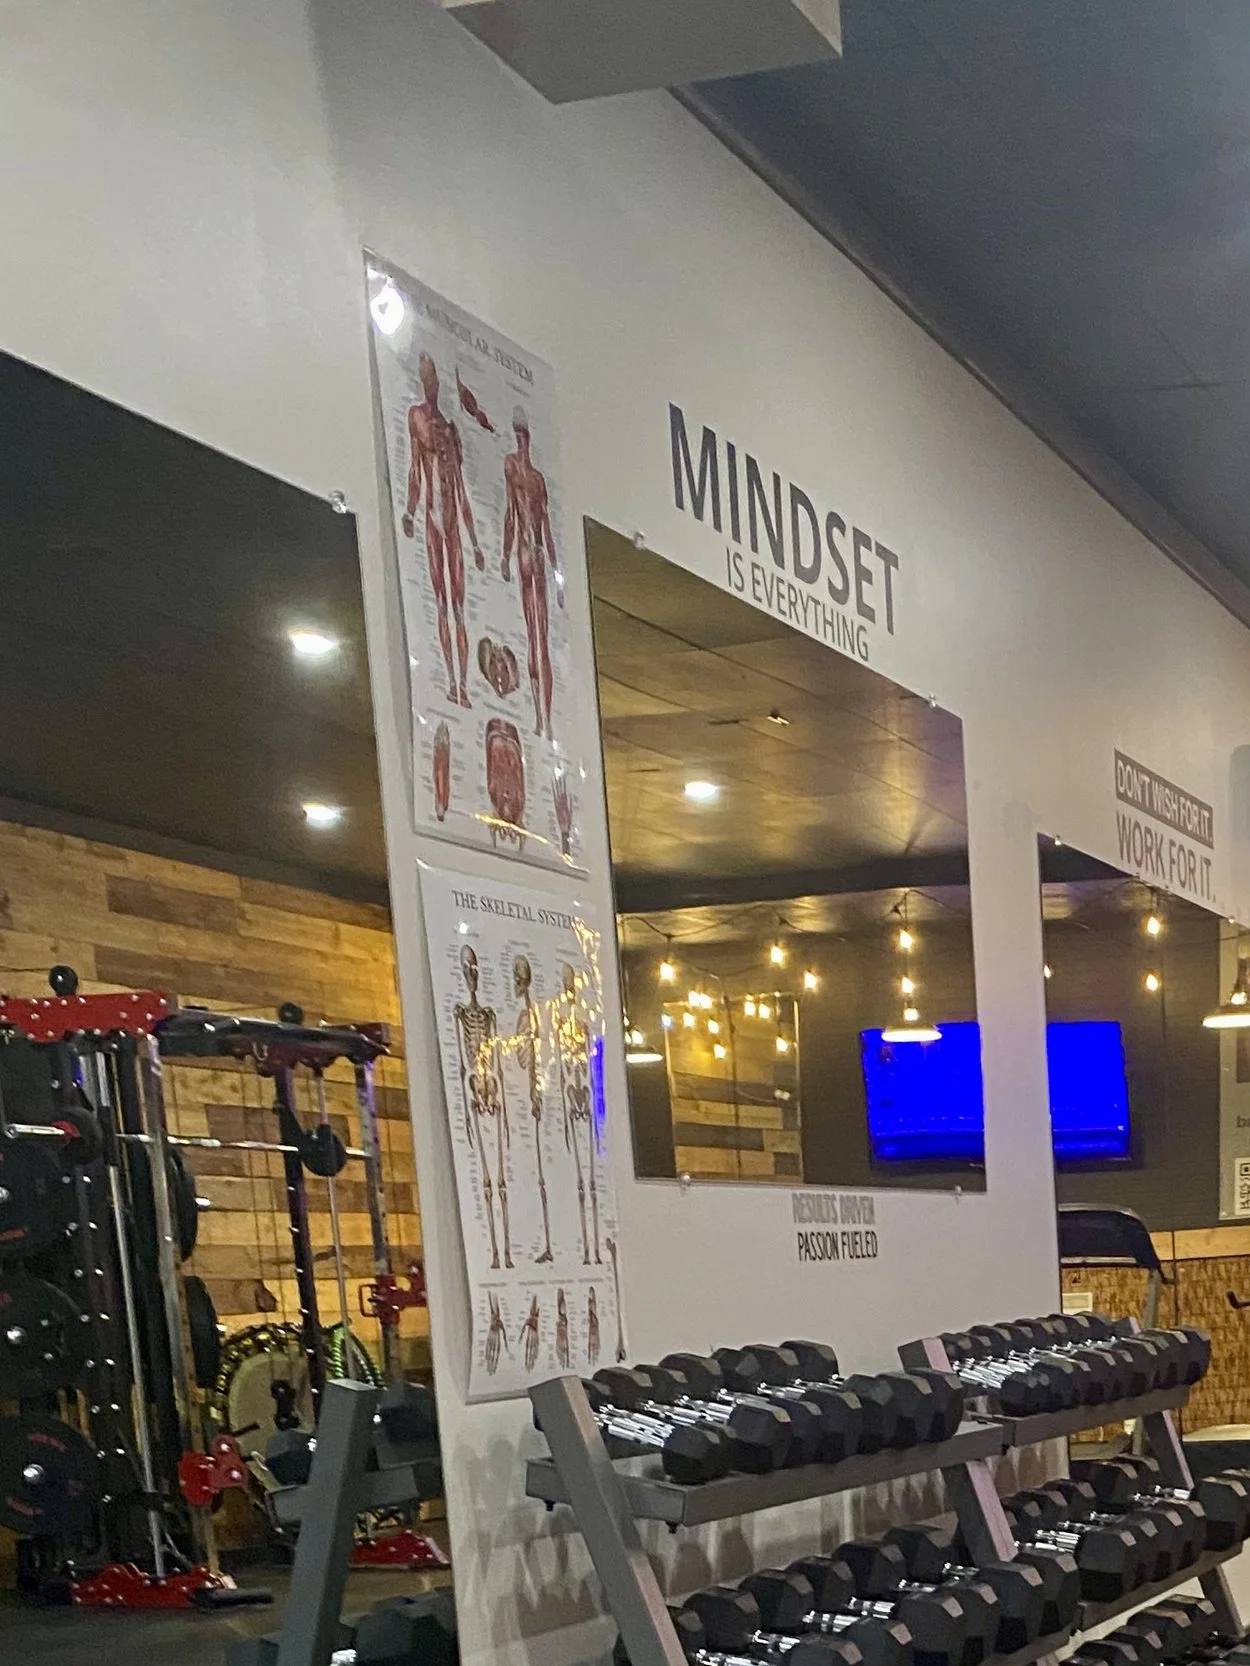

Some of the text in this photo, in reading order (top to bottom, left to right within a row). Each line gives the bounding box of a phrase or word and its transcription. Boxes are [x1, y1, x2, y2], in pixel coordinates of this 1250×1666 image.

[669, 401, 899, 636] MINDSET
[726, 547, 869, 662] IS EVERYTHING
[1151, 780, 1179, 825] WISH
[1179, 796, 1199, 835] FOR
[1116, 810, 1166, 880] WORK
[1169, 838, 1198, 895] FOR
[452, 890, 478, 911] THE
[479, 896, 537, 922] SKELETAL
[798, 1230, 878, 1262] PASSION FUELED
